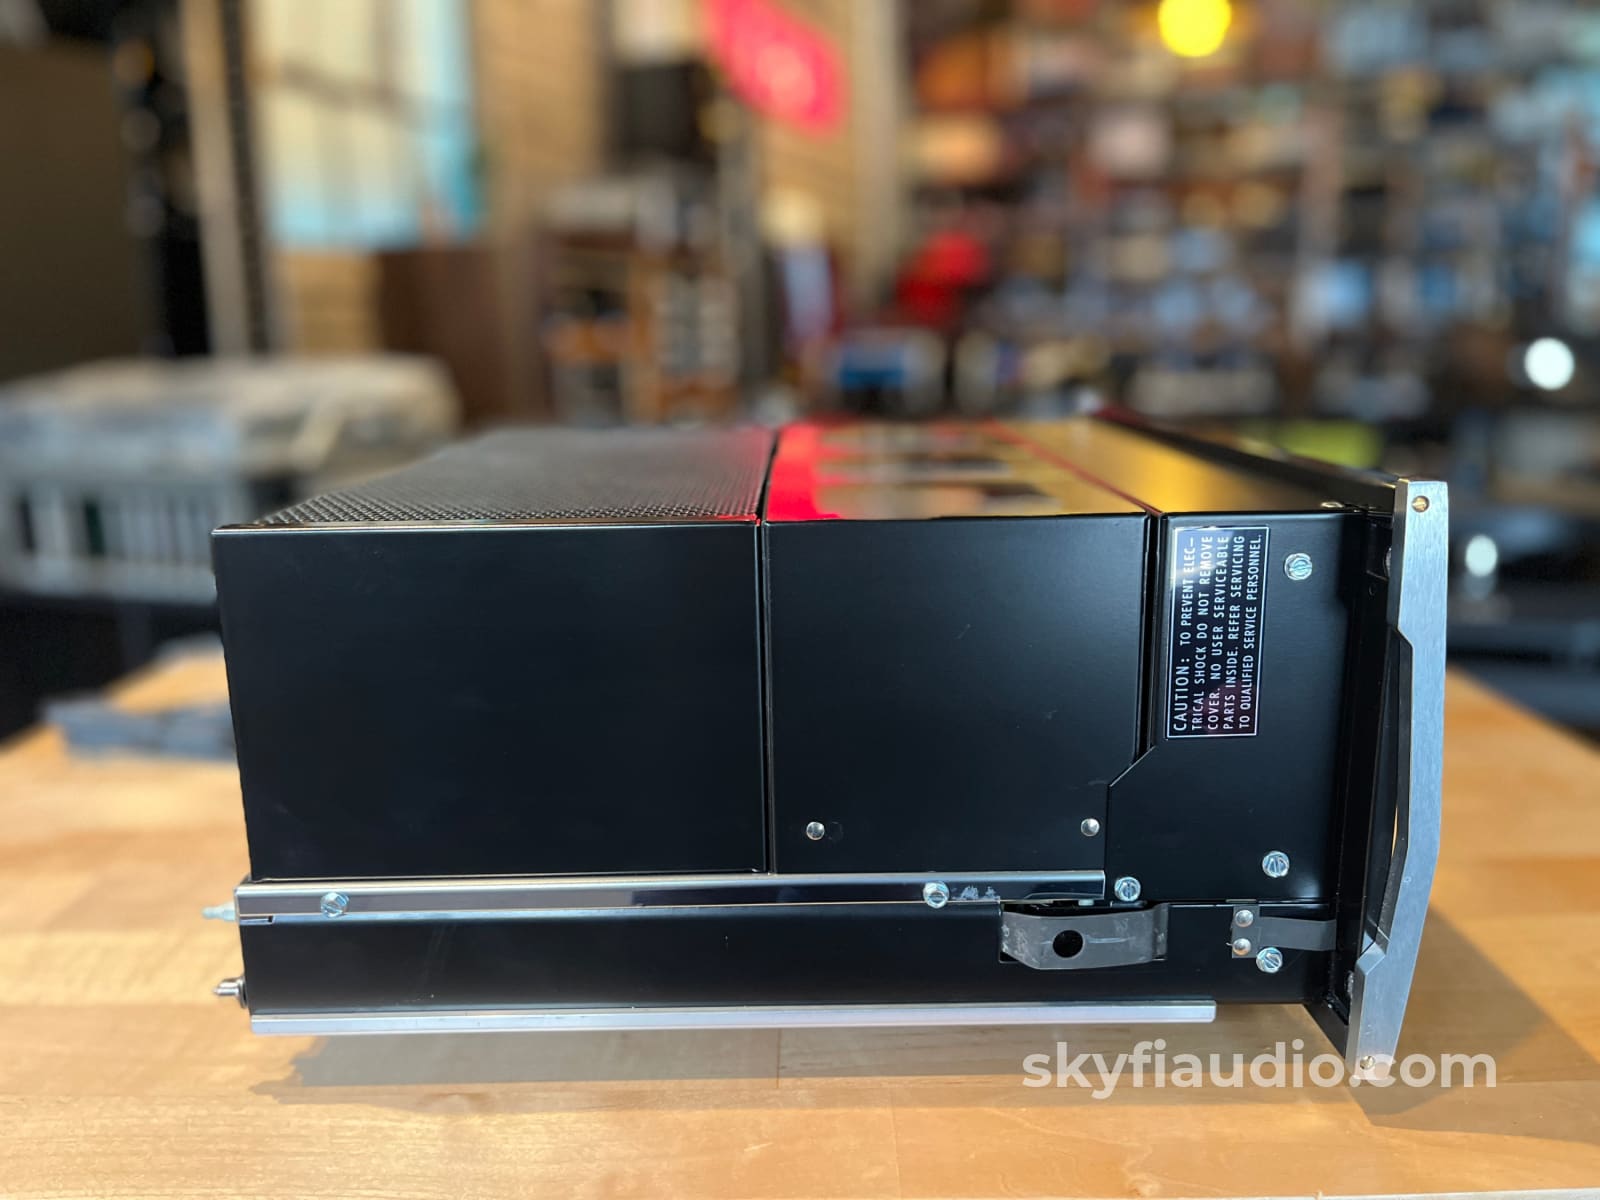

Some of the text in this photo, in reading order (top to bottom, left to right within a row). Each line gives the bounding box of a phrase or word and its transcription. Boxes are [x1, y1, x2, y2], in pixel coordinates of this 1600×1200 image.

[1173, 658, 1190, 731] CAUTION:
[1180, 632, 1191, 646] TO
[1181, 578, 1194, 626] PREVENT
[1192, 536, 1213, 731] TRICAL SHOCK DO NOT REMOVE
[1207, 536, 1229, 730] COVER. NO USER SERVICEABLE
[1223, 536, 1245, 729] PARTS INSIDE. REFER SERVICING
[1239, 534, 1262, 728] TO QUALIFIED SERVICE PERSONNEL.
